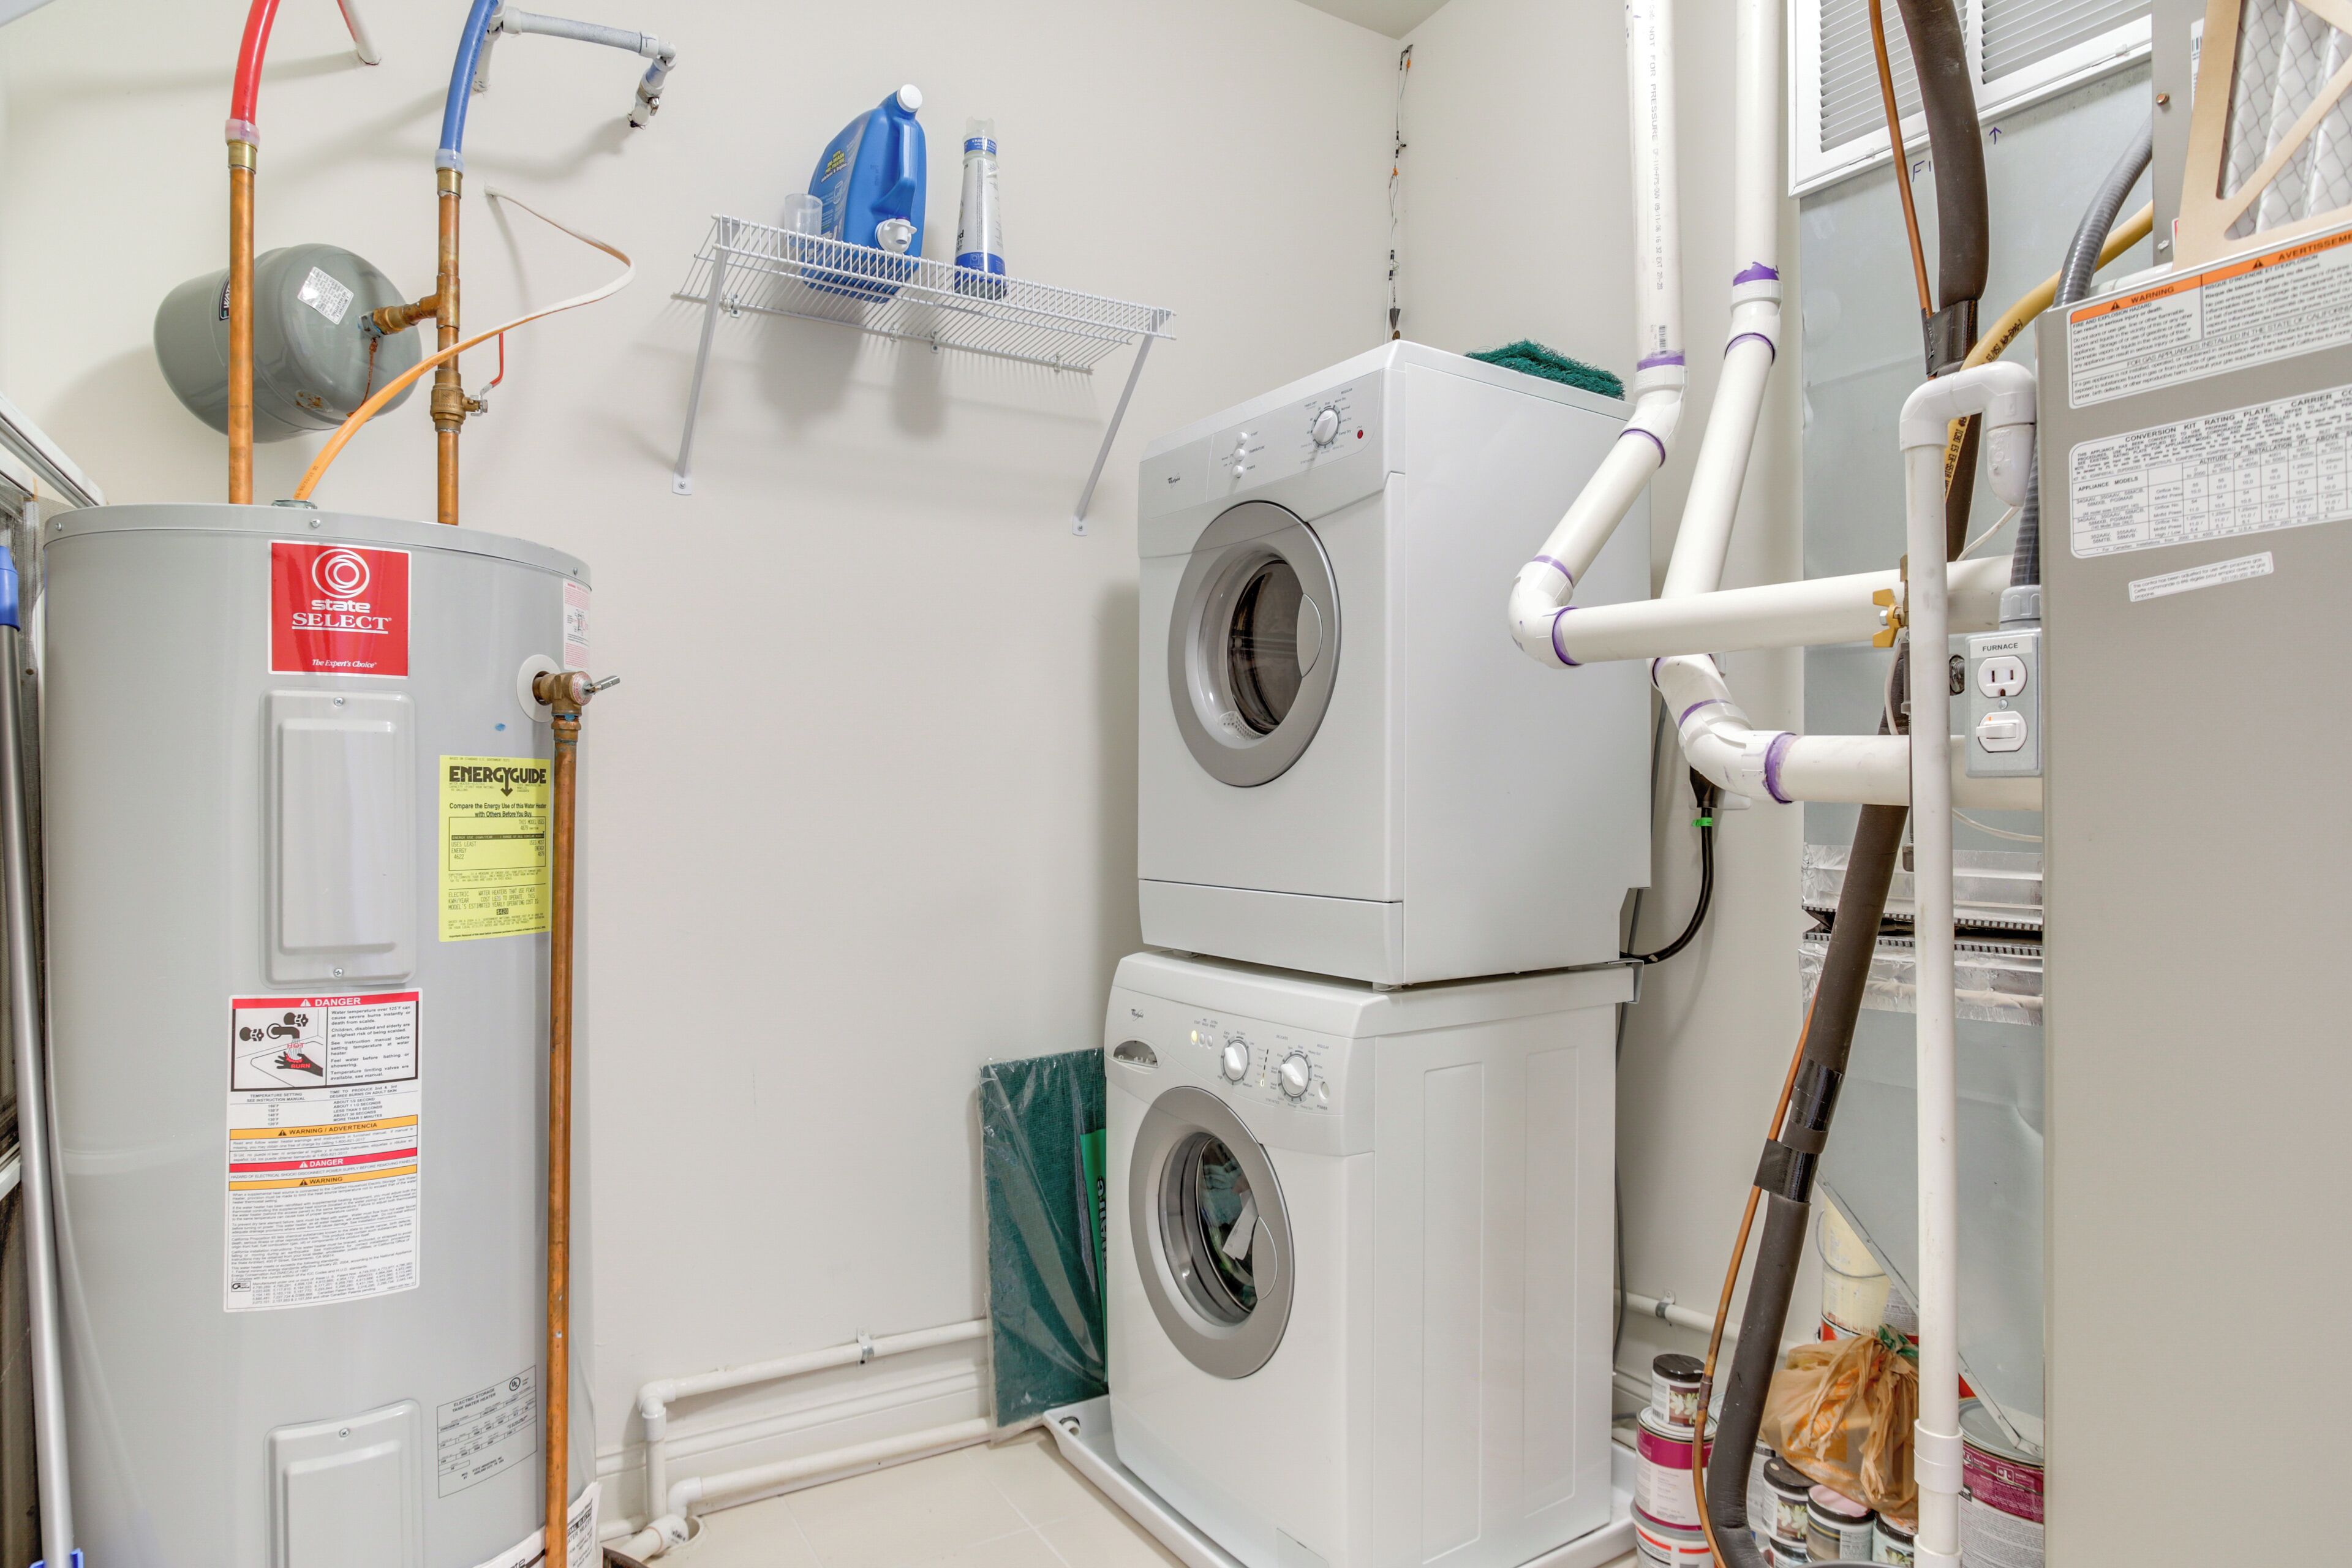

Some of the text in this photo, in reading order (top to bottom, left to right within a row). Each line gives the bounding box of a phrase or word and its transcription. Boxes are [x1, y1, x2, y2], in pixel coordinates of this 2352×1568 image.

[1650, 84, 1659, 141] PRESSURE
[2131, 286, 2174, 303] WARNING
[2097, 309, 2128, 322] EXPLOSION
[2130, 302, 2152, 312] HAZARD
[2125, 427, 2176, 443] CONVERSION
[2204, 415, 2236, 426] RATING
[2244, 407, 2271, 418] PLATE
[2291, 394, 2332, 407] CARRIER
[2199, 453, 2228, 465] ALTITUDE
[2248, 441, 2292, 455] INSTALLATION
[2316, 433, 2340, 442] ABOVE
[2078, 476, 2138, 491] APPLIANCE MODELS
[311, 599, 370, 613] state
[292, 612, 389, 630] SELECT
[1981, 642, 2019, 652] FURNACE
[449, 766, 547, 785] ENERGYGUIDE
[315, 997, 361, 1007] DANGER
[328, 1123, 378, 1133] ADVERTENCIA
[309, 1158, 344, 1167] DANGER
[309, 1176, 343, 1185] WARNING
